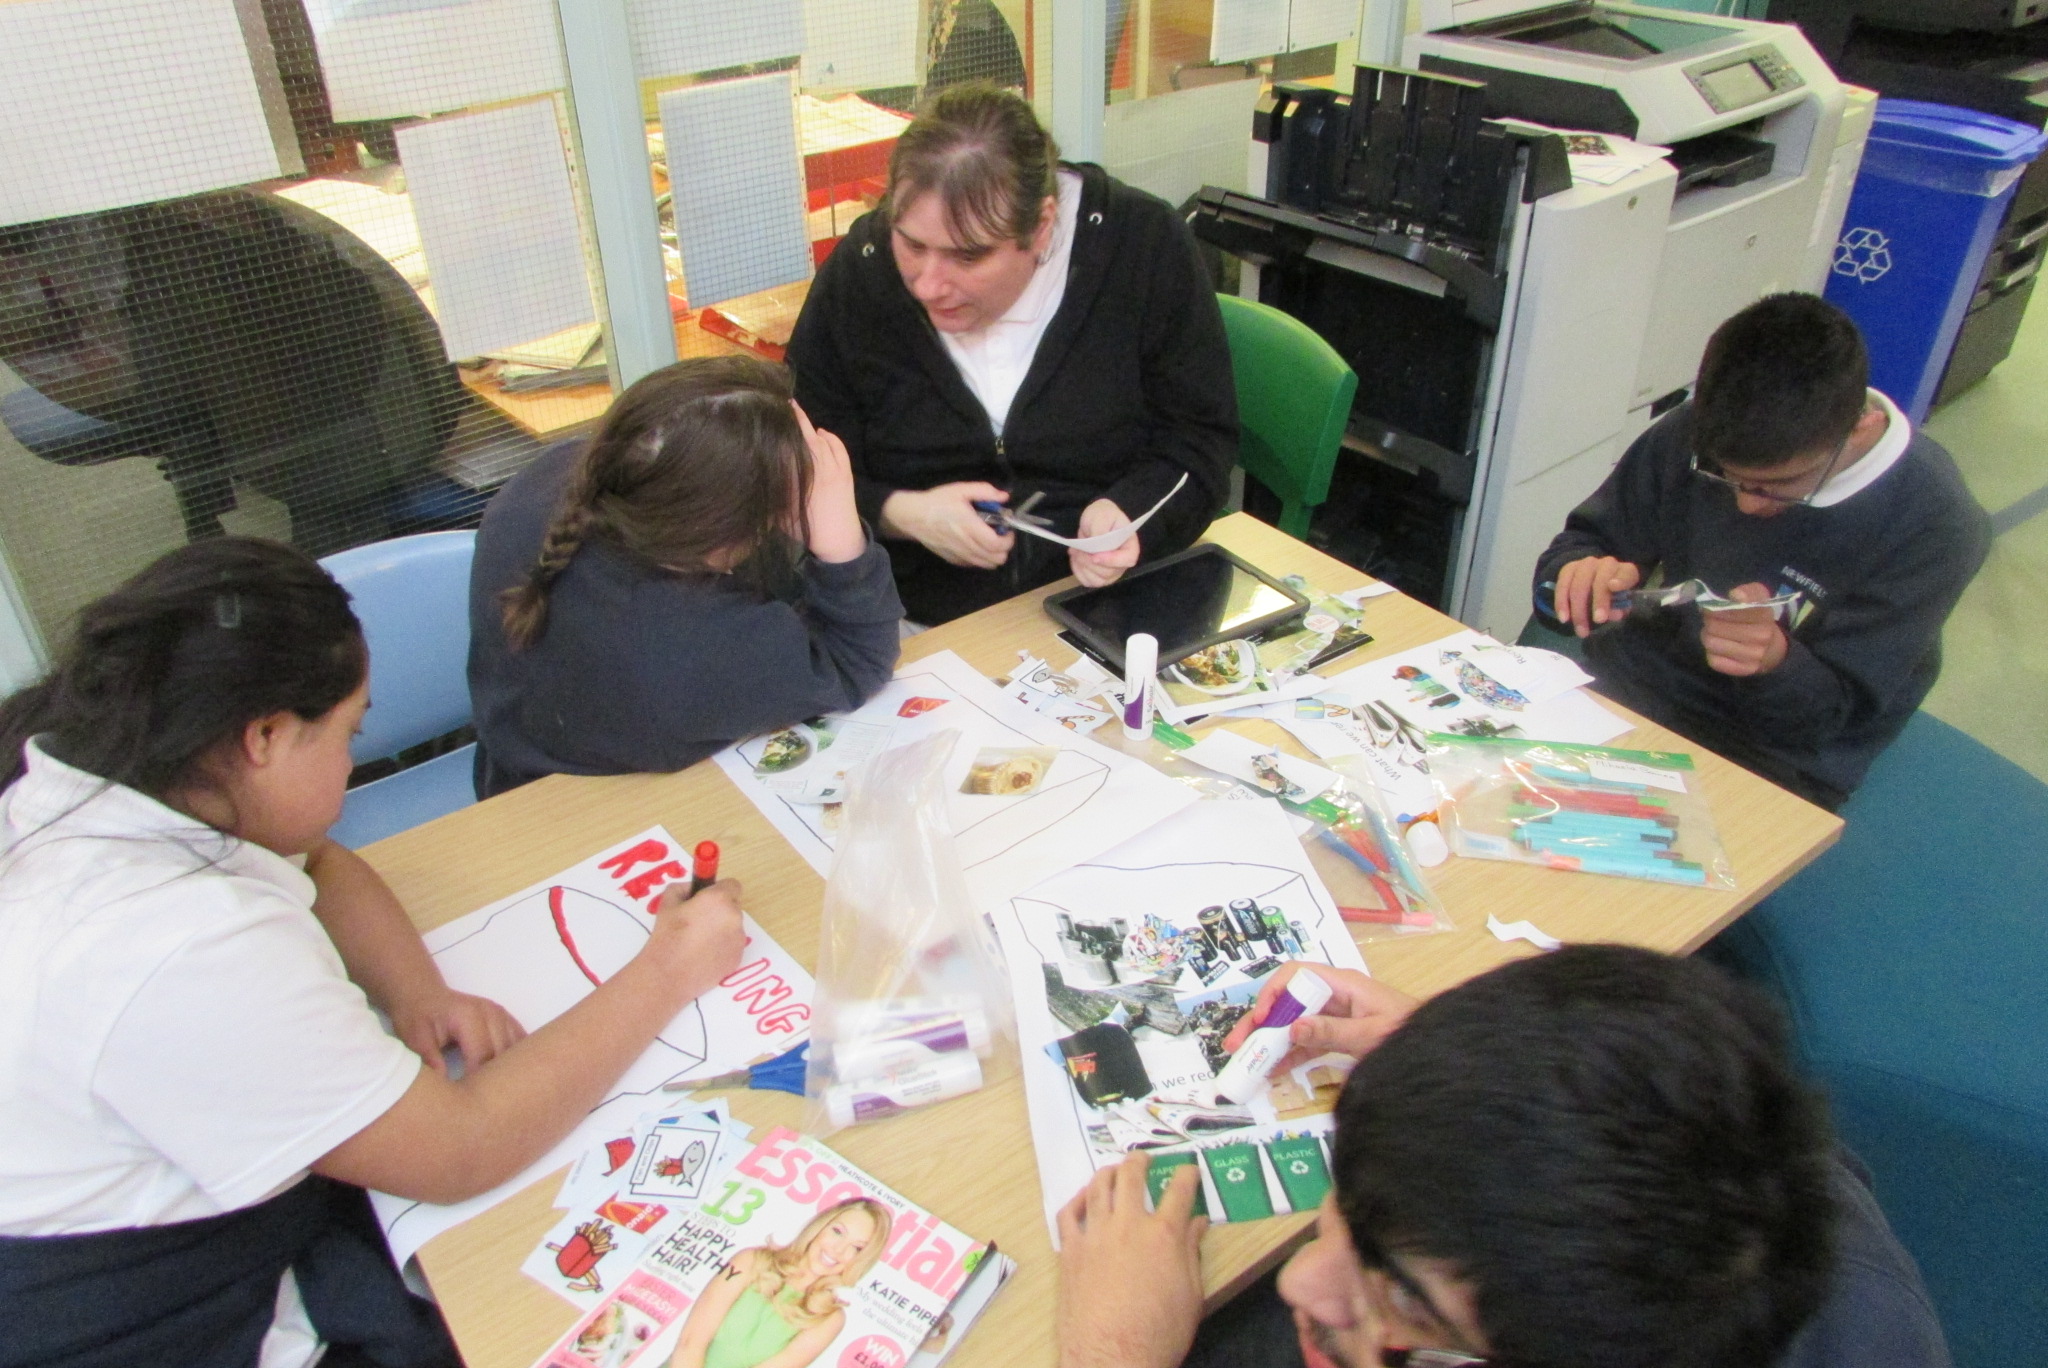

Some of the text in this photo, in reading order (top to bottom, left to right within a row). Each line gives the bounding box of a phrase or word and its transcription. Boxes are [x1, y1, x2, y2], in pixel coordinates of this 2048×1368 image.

[1162, 1073, 1186, 1090] we
[1213, 1155, 1250, 1168] GLASS
[1273, 1149, 1316, 1161] PLASTIC
[838, 1163, 878, 1192] HEATHCOTE
[883, 1192, 905, 1210] IVORY
[701, 1180, 766, 1225] 13
[678, 1219, 736, 1254] HAPPY
[652, 1245, 700, 1276] HAIR!
[665, 1232, 742, 1281] HEALTHY
[869, 1280, 909, 1309] KATIE
[865, 1336, 900, 1366] WIN
